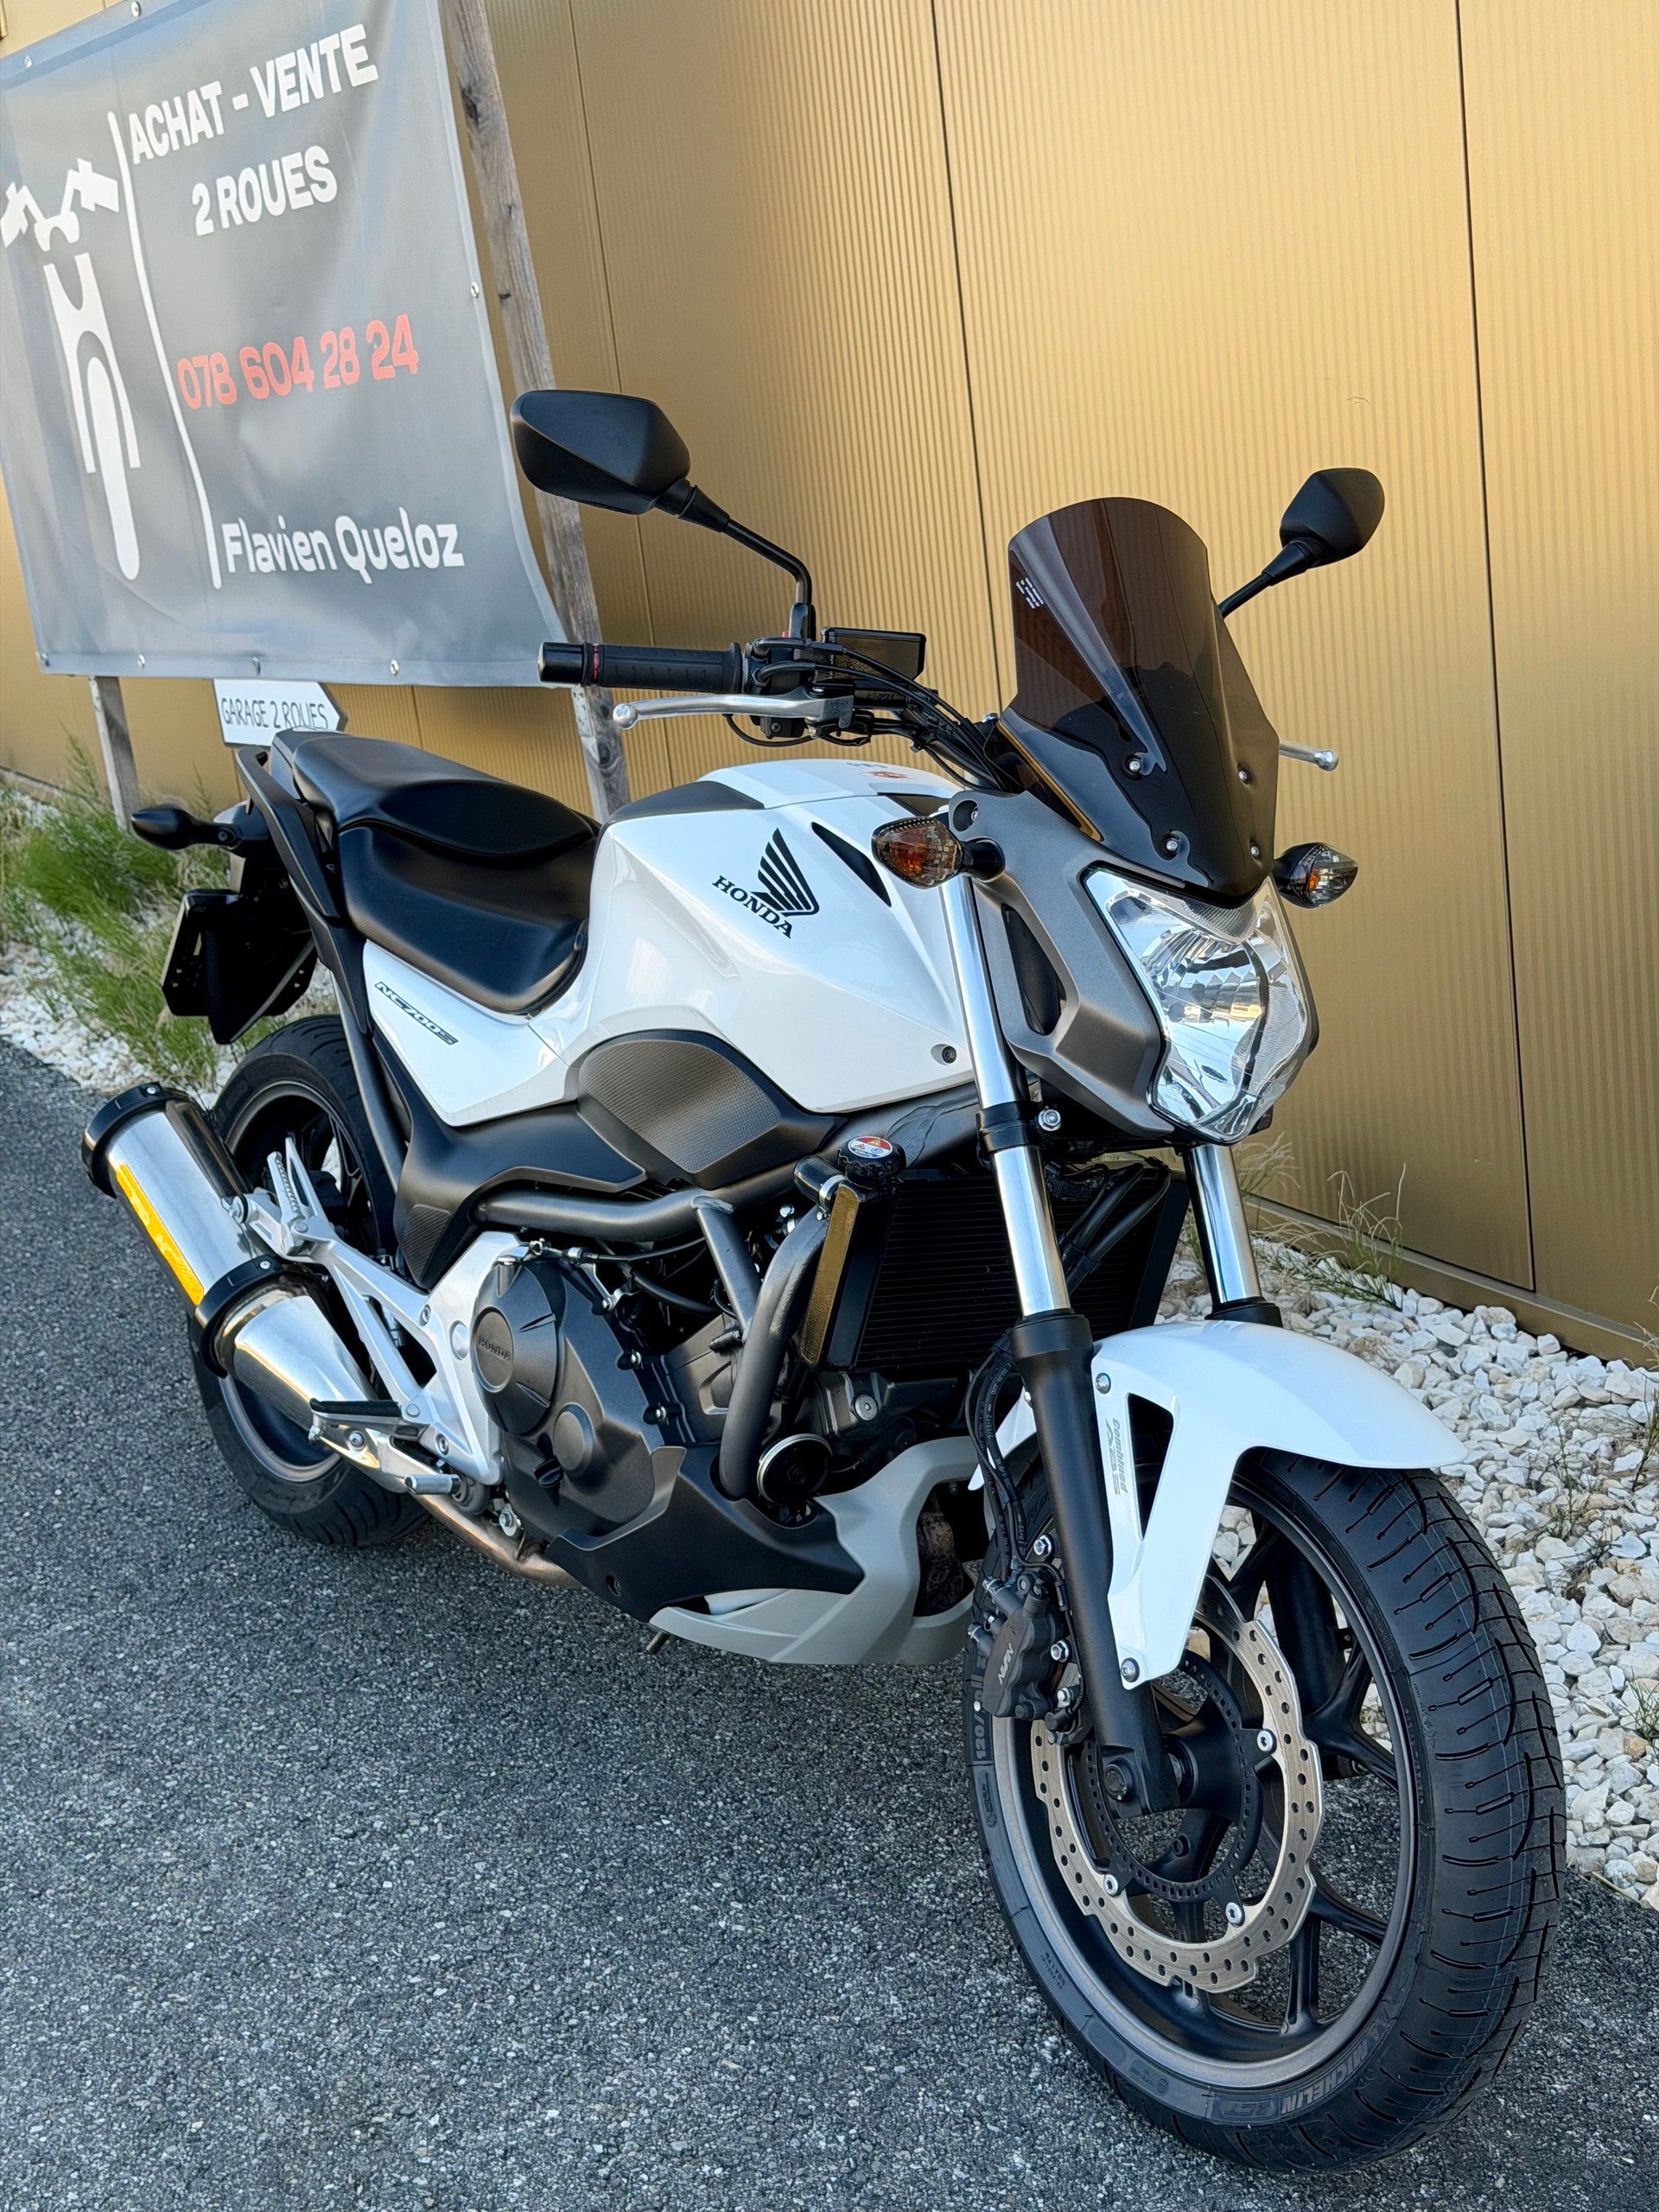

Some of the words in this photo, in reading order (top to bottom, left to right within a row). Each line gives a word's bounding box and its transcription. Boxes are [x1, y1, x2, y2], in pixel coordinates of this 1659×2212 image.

[129, 80, 225, 165] ACHAT
[250, 23, 379, 118] VENTE
[192, 182, 215, 237] 2
[216, 145, 338, 229] ROUES
[177, 353, 237, 410] 078
[240, 337, 314, 399] 604
[320, 327, 359, 387] 28
[366, 315, 418, 380] 24
[222, 515, 337, 573] Flavien
[336, 506, 465, 583] Queloz
[221, 697, 269, 728] GARAGE
[270, 701, 281, 728] 2
[282, 702, 328, 729] ROUES
[712, 875, 793, 938] HONDA
[374, 982, 459, 1046] NC700S
[478, 1336, 512, 1362] HONDA
[1105, 1419, 1121, 1496] ABS
[1113, 1418, 1128, 1494] Combined
[974, 1689, 987, 1759] 120/0
[1281, 2033, 1369, 2115] MICHELIN
